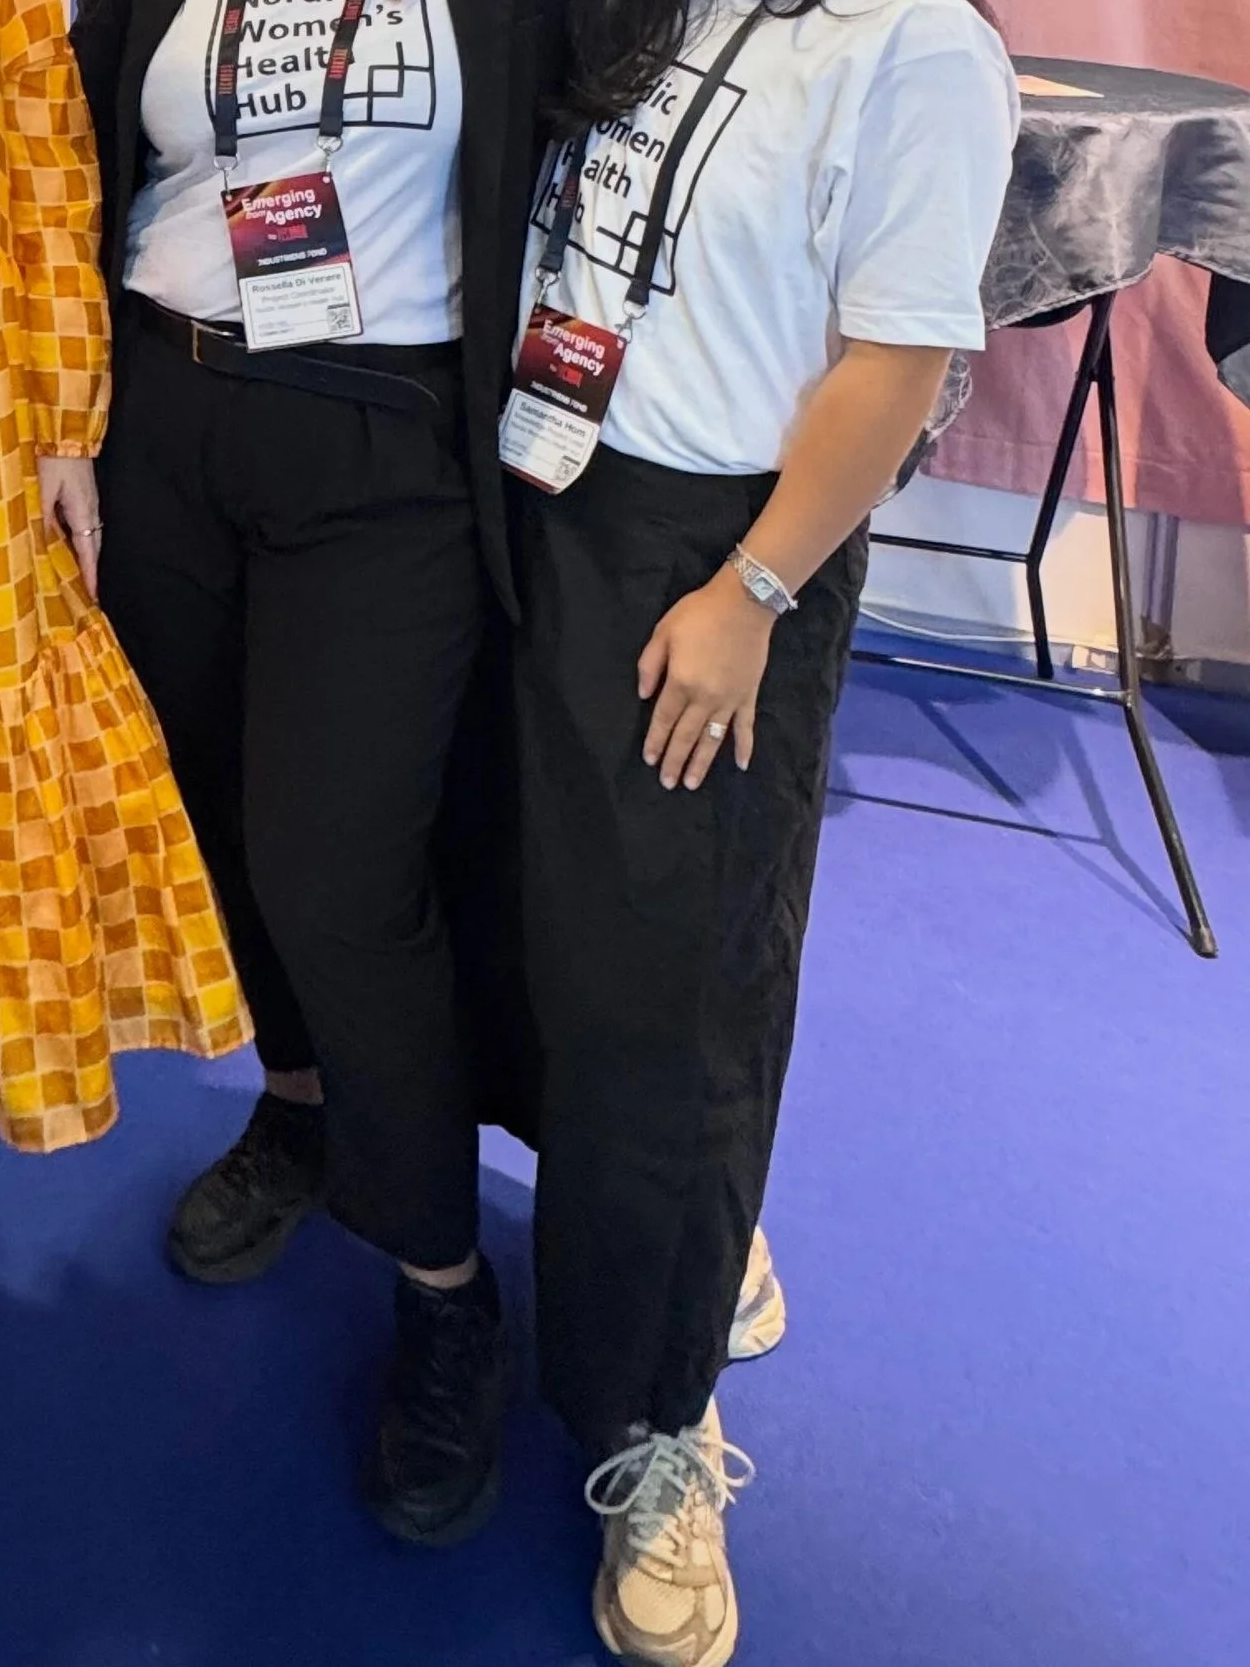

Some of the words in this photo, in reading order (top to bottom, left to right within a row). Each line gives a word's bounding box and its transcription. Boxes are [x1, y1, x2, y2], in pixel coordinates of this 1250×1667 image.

[238, 46, 356, 79] Healt
[241, 188, 316, 212] Emerging
[265, 203, 323, 225] Agency
[542, 319, 605, 359] Emerging
[553, 343, 605, 377] Agency
